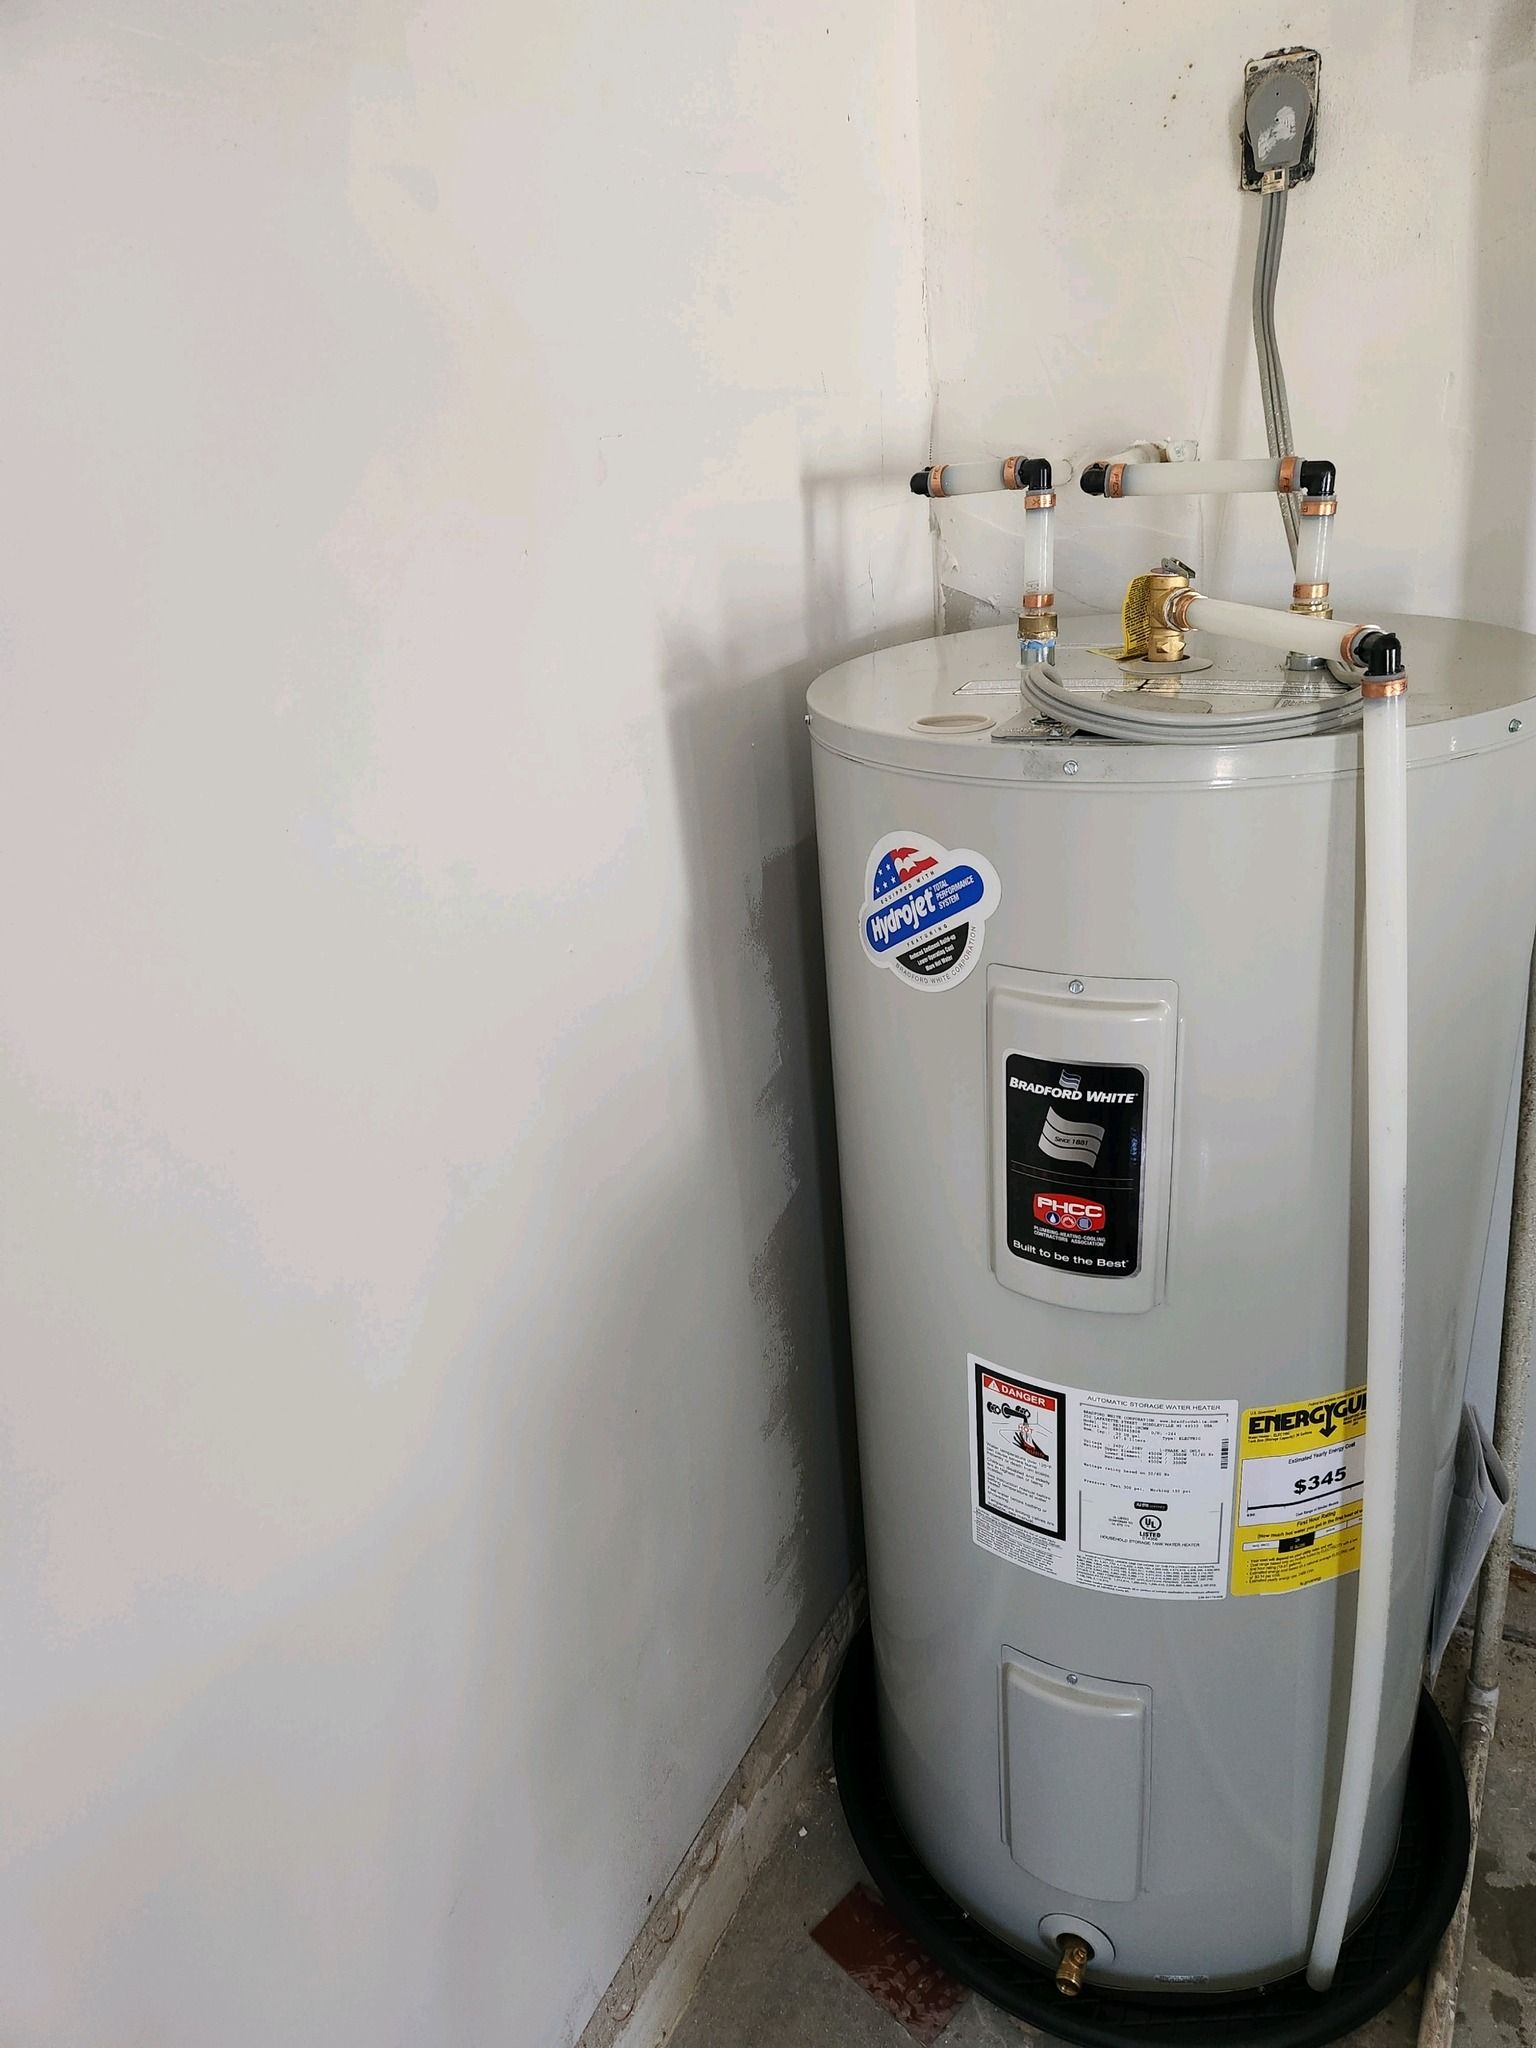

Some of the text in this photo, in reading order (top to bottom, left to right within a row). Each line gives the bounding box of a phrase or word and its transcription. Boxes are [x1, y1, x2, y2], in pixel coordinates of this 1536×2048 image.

[880, 870, 936, 905] EQUIPPED WITH
[932, 879, 949, 893] TOTAL
[935, 874, 975, 901] PERFORMANCE
[938, 893, 960, 910] SYSTEM
[871, 888, 936, 945] Hydrojet
[905, 923, 949, 948] FEATURING
[895, 925, 977, 985] BRADFORD WHITE CORPORATION
[1009, 1077, 1135, 1104] BRADFORD WHITE
[1072, 1138, 1088, 1146] 1881
[1037, 1196, 1103, 1218] PHCC
[1033, 1230, 1104, 1247] CONTRACTORS ASSOCIATION
[1013, 1239, 1127, 1268] Built to be the Best
[1001, 1385, 1046, 1407] DANGER
[1087, 1395, 1128, 1407] AUTOMATIC
[1130, 1402, 1164, 1410] STORAGE
[1288, 1441, 1356, 1465] Estimated Yearly Energy Cost
[1293, 1466, 1347, 1495] $345
[1144, 1517, 1157, 1529] UL
[1296, 1510, 1337, 1527] First Hour Rating
